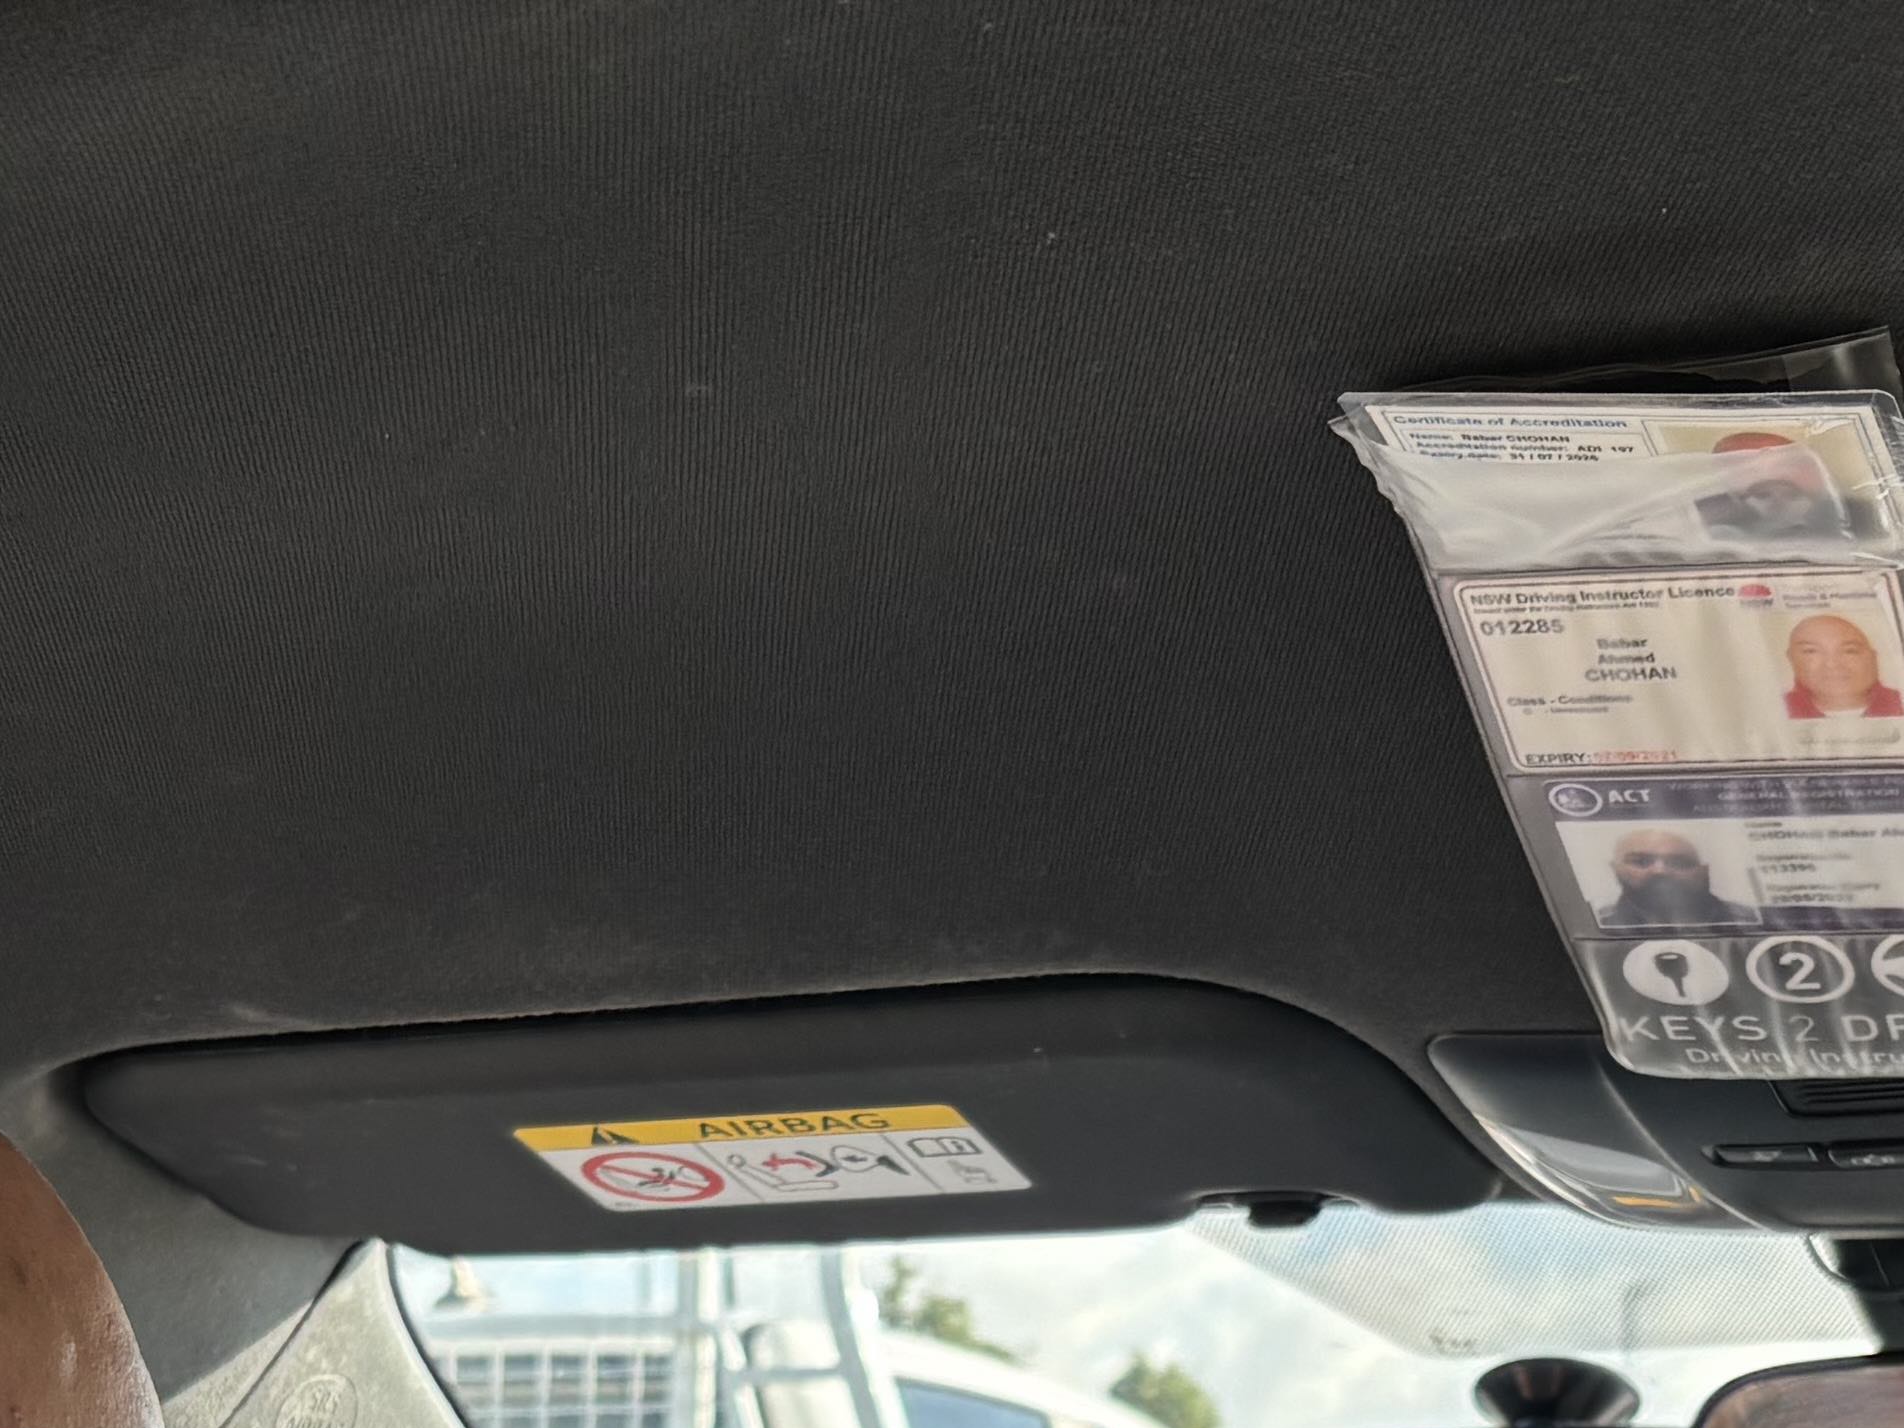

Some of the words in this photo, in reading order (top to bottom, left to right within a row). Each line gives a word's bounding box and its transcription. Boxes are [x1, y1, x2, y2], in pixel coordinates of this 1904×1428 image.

[1393, 415, 1482, 425] Certificate
[1487, 417, 1504, 426] of
[1510, 418, 1627, 427] Accreditation
[1470, 593, 1511, 605] NSW
[1516, 591, 1577, 604] Driving
[1579, 588, 1664, 602] Instructor
[1667, 586, 1736, 599] Licence
[1480, 618, 1565, 636] 012285
[1597, 652, 1656, 665] Ahmed
[1584, 667, 1678, 681] CHOHAN
[1525, 752, 1592, 764] EXPIRY:
[1608, 788, 1651, 803] ACT
[1619, 1015, 1768, 1042] KEYS
[1788, 1015, 1819, 1042] 2
[698, 1112, 891, 1139] AIRBAG
